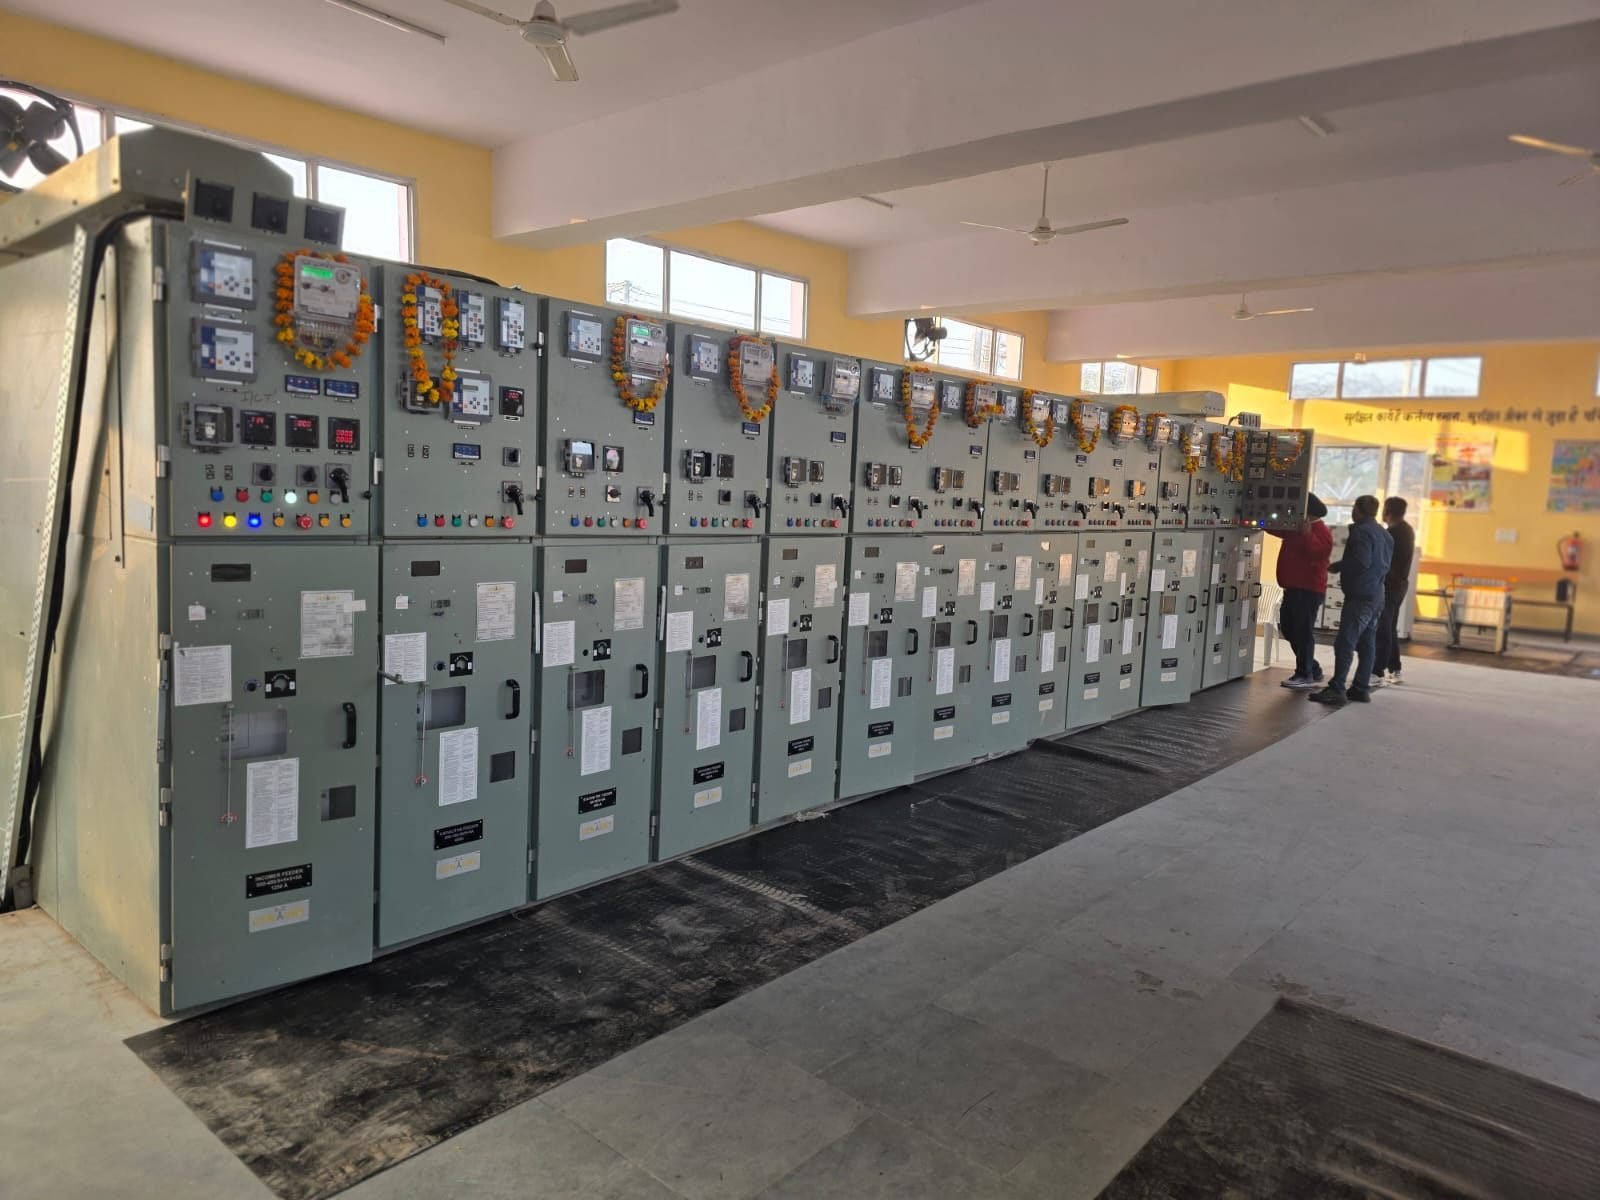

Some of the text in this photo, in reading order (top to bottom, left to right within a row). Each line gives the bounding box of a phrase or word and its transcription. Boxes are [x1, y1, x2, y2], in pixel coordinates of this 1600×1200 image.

[1344, 410, 1373, 426] सुरक्षित
[1403, 409, 1434, 422] कर्तव्य
[281, 868, 304, 877] FEEDER
